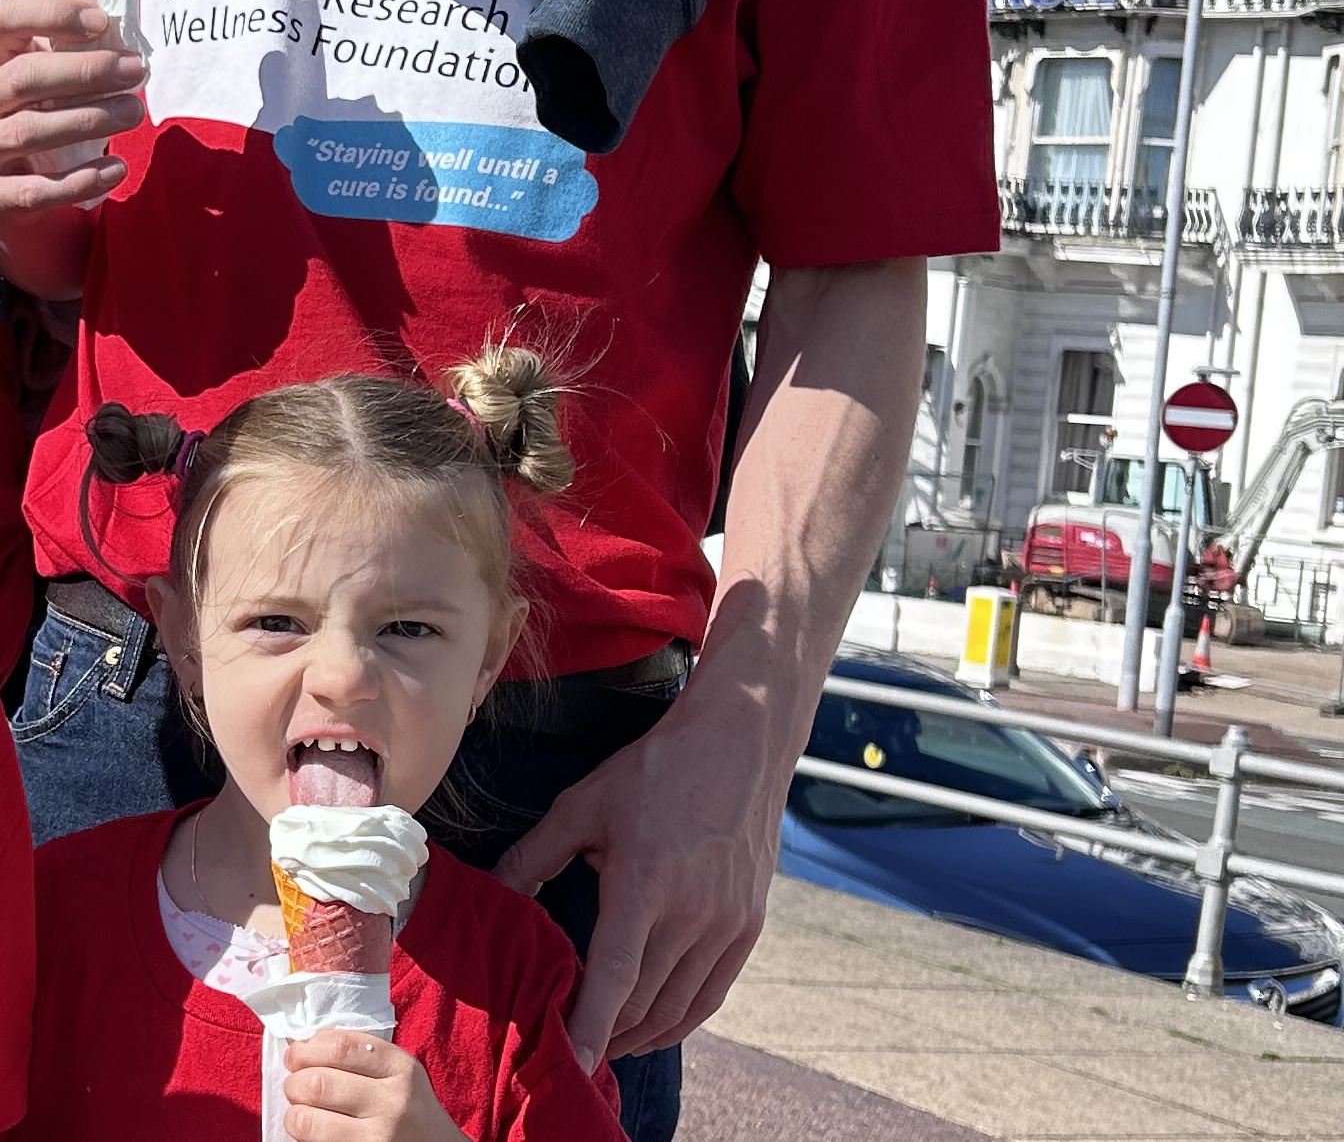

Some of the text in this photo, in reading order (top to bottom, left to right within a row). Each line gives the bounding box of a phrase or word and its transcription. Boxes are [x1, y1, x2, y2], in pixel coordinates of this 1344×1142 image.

[162, 6, 529, 92] Wellness Foundatio
[307, 138, 559, 185] "Staying well until a
[328, 179, 380, 200] cure
[386, 177, 408, 199] is
